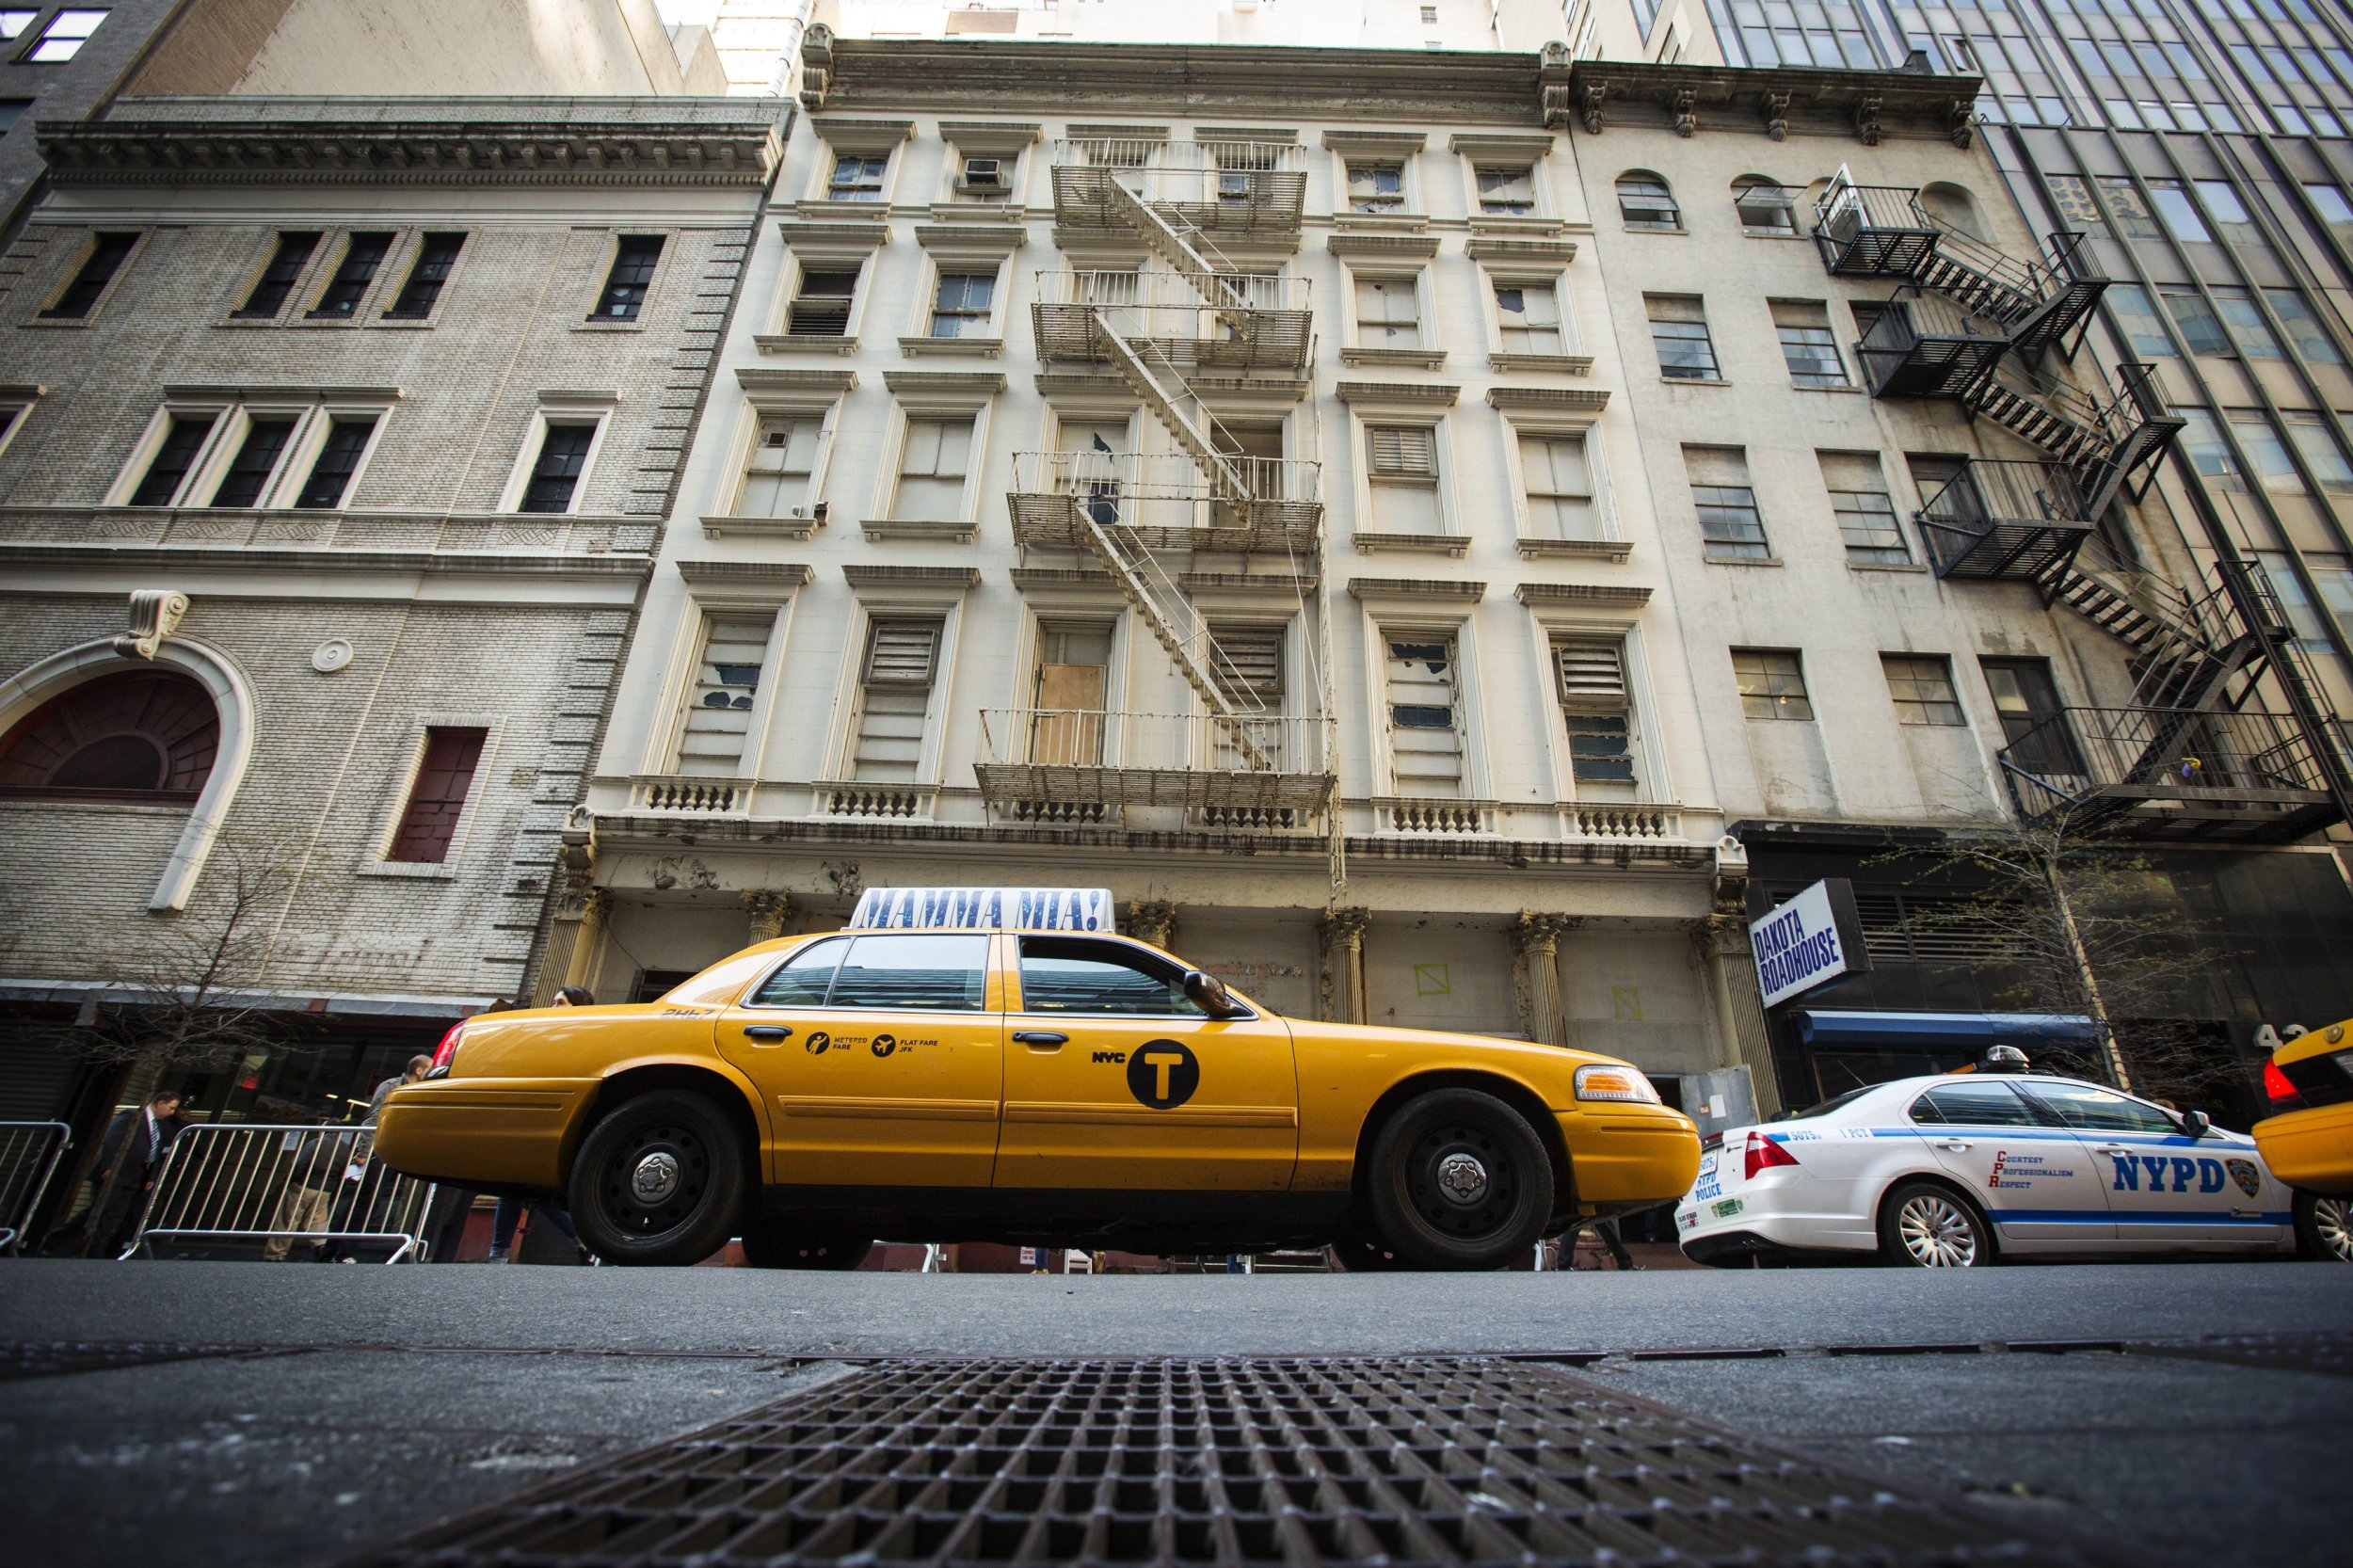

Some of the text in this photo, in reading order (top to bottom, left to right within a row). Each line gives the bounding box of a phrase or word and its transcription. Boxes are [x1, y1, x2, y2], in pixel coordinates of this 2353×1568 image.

[857, 889, 1101, 931] MAMMA MIA!
[1753, 908, 1805, 963] DAKOTA
[1760, 927, 1839, 996] ROADHOUSE
[1092, 1051, 1183, 1100] NYC T
[1791, 1130, 1817, 1141] 5075
[1848, 1128, 1869, 1138] PCT
[1997, 1151, 2044, 1163] COURTESY
[1993, 1162, 2073, 1177] PROFESSIONALISM
[2112, 1156, 2225, 1193] NYPD
[1697, 1173, 1716, 1188] NYPD
[1988, 1176, 2031, 1189] RESPECT
[1695, 1183, 1722, 1202] POLICE
